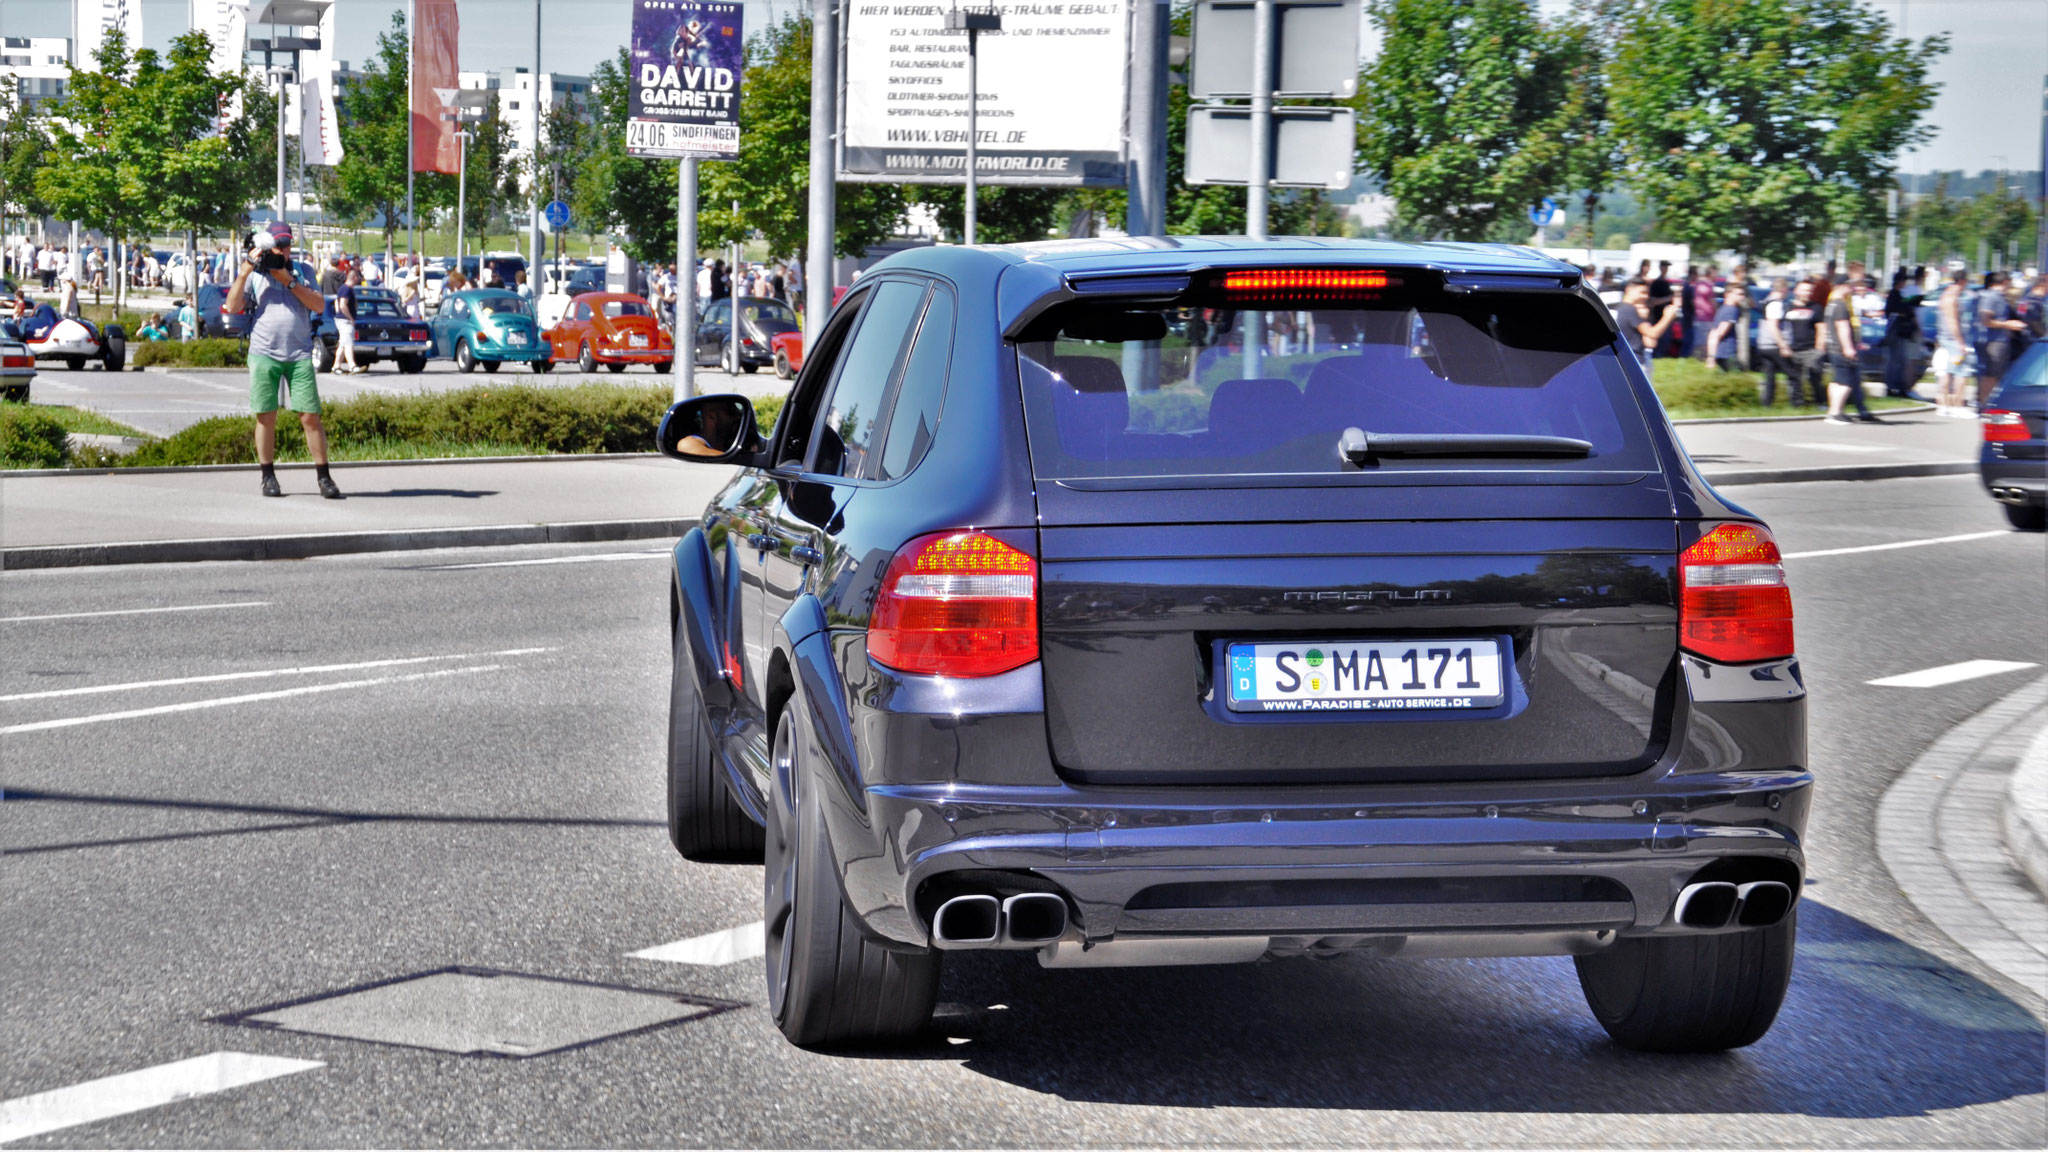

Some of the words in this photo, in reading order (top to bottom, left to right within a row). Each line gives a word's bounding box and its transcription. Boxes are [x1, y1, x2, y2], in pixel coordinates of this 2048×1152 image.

[644, 1, 675, 9] OPEN
[681, 3, 702, 11] AIR
[708, 4, 735, 12] 2017
[859, 5, 888, 16] HIER
[893, 5, 944, 16] WERDEN
[890, 28, 906, 36] 153
[1012, 28, 1033, 36] UND
[1036, 28, 1111, 36] THEMENZIMMER
[889, 44, 911, 53] BAR,
[890, 60, 965, 69] TAGUNGSRÄUME
[641, 63, 734, 91] DAVID
[888, 76, 943, 85] SKYOFFICES
[640, 88, 734, 109] GARRETT
[643, 106, 690, 116] CROSSOVER
[691, 108, 705, 117] MIT
[706, 110, 729, 119] BAND
[672, 125, 736, 141] SINDELFINGEN
[1275, 651, 1301, 692] S
[1332, 649, 1388, 691] MA
[1401, 648, 1481, 690] 171
[1240, 678, 1250, 691] D
